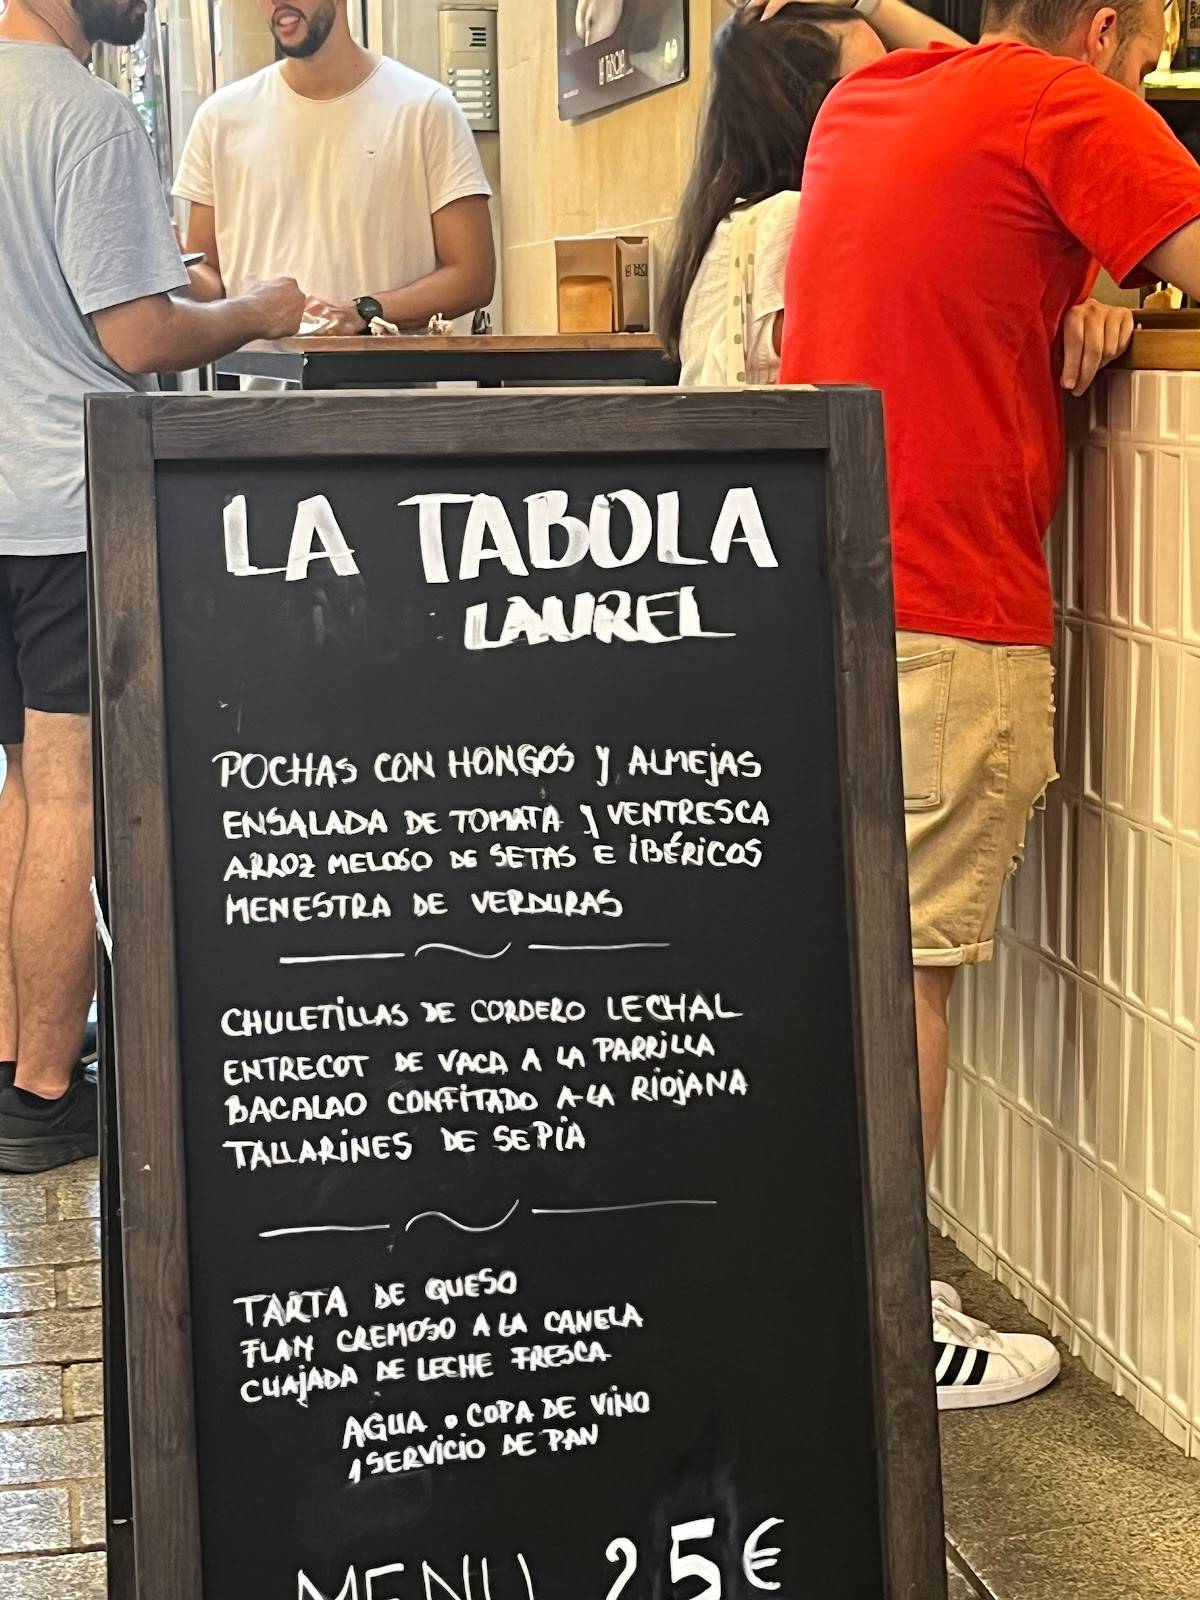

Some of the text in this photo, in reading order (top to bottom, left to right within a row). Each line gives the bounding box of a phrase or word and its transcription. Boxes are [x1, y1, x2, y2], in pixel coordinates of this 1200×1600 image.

[222, 486, 779, 584] LA TABOLA
[463, 585, 737, 650] LAUREL
[211, 750, 358, 790] POCHAS
[373, 750, 436, 783] CON
[448, 742, 575, 781] HONGOS
[628, 742, 762, 788] ALMEJAS
[222, 805, 388, 840] ENSALADA
[403, 810, 442, 835] DE
[606, 798, 770, 827] VENTRESCA
[223, 851, 316, 882] ARROZ
[327, 847, 434, 874] MELOSO
[449, 850, 478, 870] DE
[489, 841, 577, 871] SETAS
[592, 844, 617, 865] E
[225, 888, 623, 925] MENESTRA DE VERDURAS
[220, 993, 743, 1037] CHULETILLAS DE CORDERO LECHAL
[223, 1055, 370, 1087] ENTRECOT
[394, 1051, 424, 1073] DE
[437, 1048, 509, 1076] VACA
[521, 1047, 543, 1072] A
[556, 1046, 586, 1070] LA
[224, 1091, 368, 1126] BACALAO
[440, 1127, 478, 1153] DE
[233, 1267, 517, 1328] TARTA DE QUESO
[240, 1302, 644, 1369] FLAN CREMOSO A LA CANELA
[240, 1340, 612, 1408] CUAJADA DE LECHE FRESCA
[342, 1410, 428, 1450] AGUA
[466, 1399, 535, 1428] COPA
[541, 1396, 577, 1420] DE
[589, 1384, 651, 1418] VINO
[501, 1431, 537, 1457] DE
[540, 1423, 599, 1452] PAN
